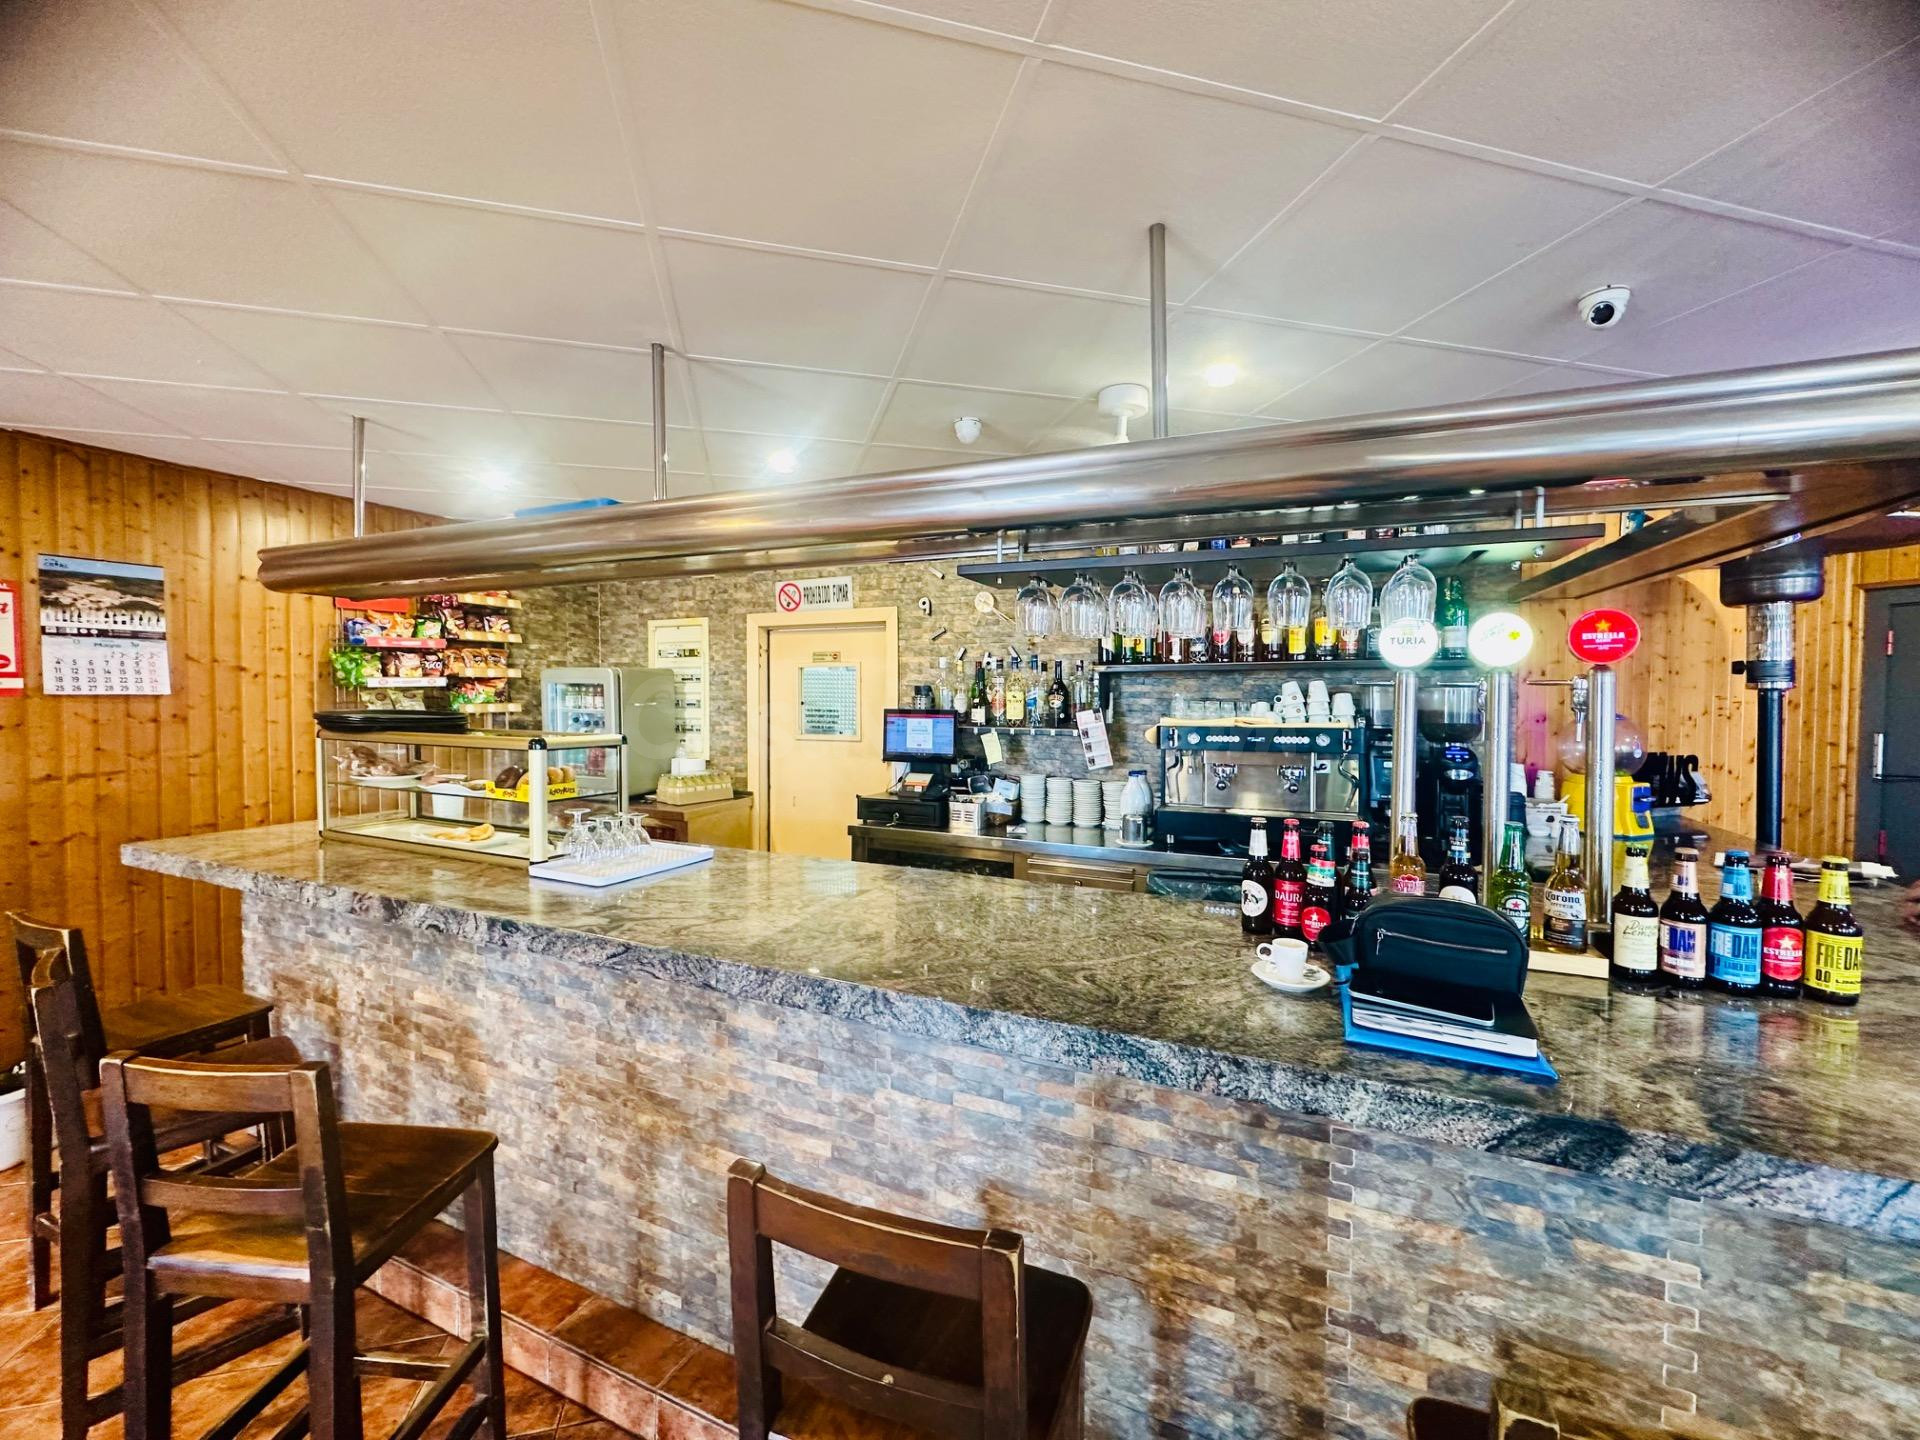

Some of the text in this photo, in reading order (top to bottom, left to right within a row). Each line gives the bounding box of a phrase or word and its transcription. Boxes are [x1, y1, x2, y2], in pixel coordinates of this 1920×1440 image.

[803, 583, 849, 604] PROHIBIDO FUMAR
[919, 596, 932, 616] 9
[1390, 636, 1426, 645] TURIA
[1582, 632, 1625, 640] ESTRELLA
[1545, 890, 1581, 904] Corona
